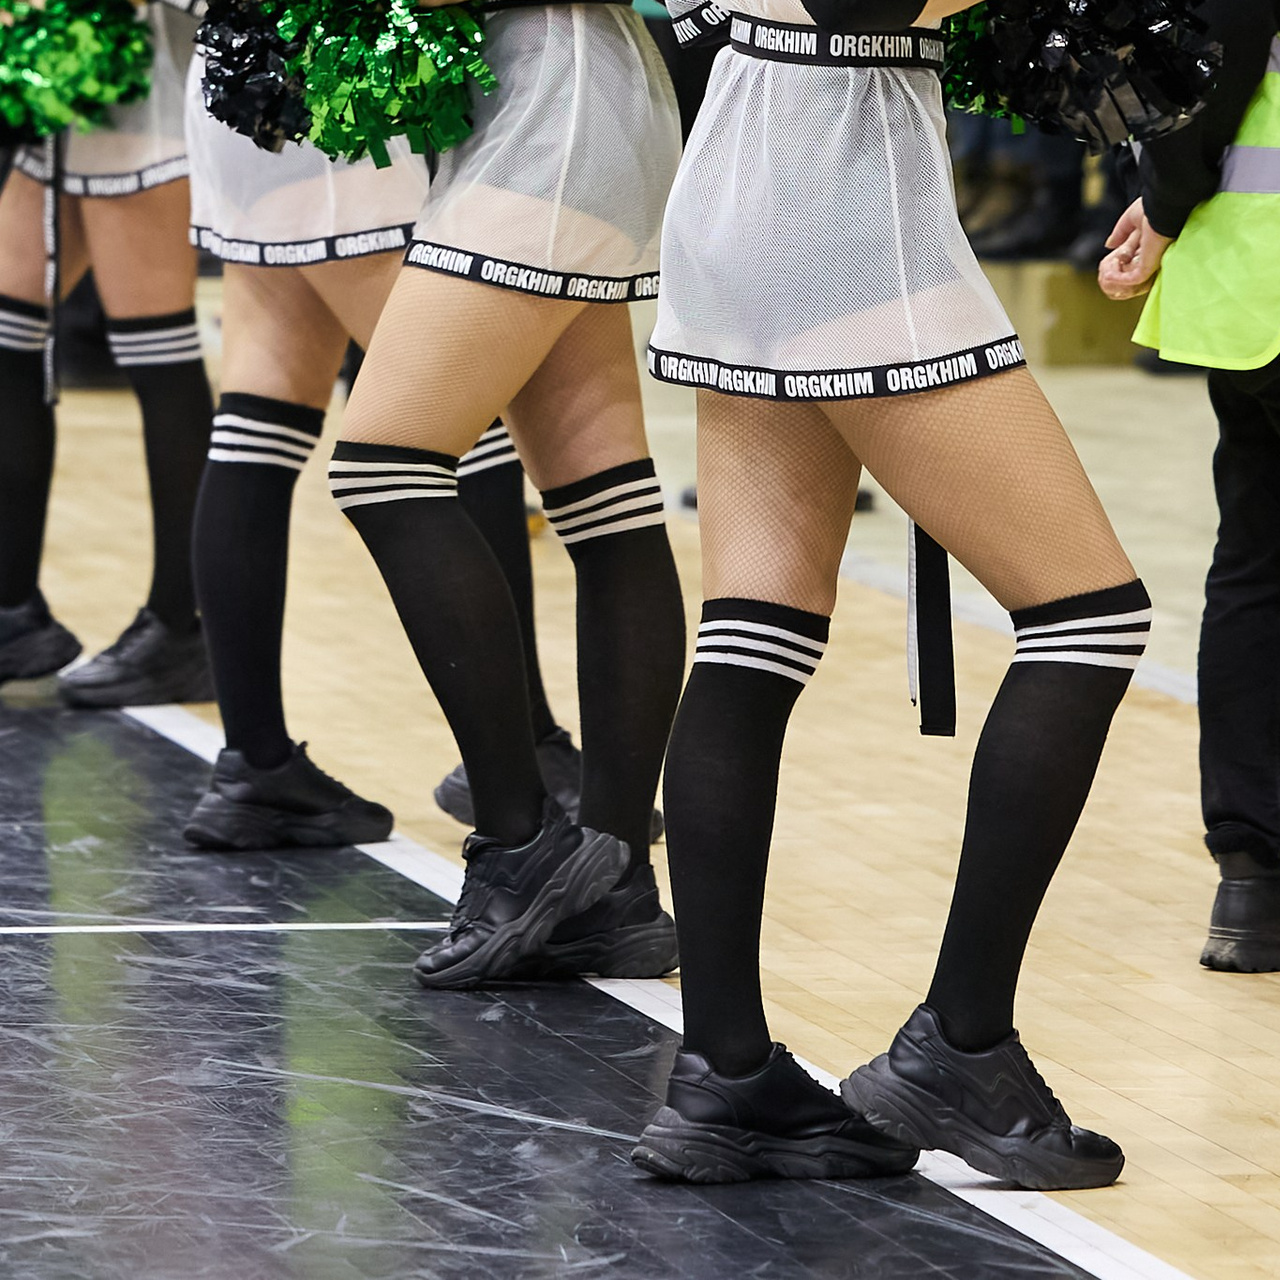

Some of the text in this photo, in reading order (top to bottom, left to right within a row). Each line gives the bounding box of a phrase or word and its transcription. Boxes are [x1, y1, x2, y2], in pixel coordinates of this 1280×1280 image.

[754, 24, 817, 56] ORGKHIM
[829, 34, 913, 58] ORGKHIM
[480, 260, 563, 296] ORGKHIM
[784, 373, 875, 398] ORGKHIM
[886, 352, 978, 392] ORGKHIM
